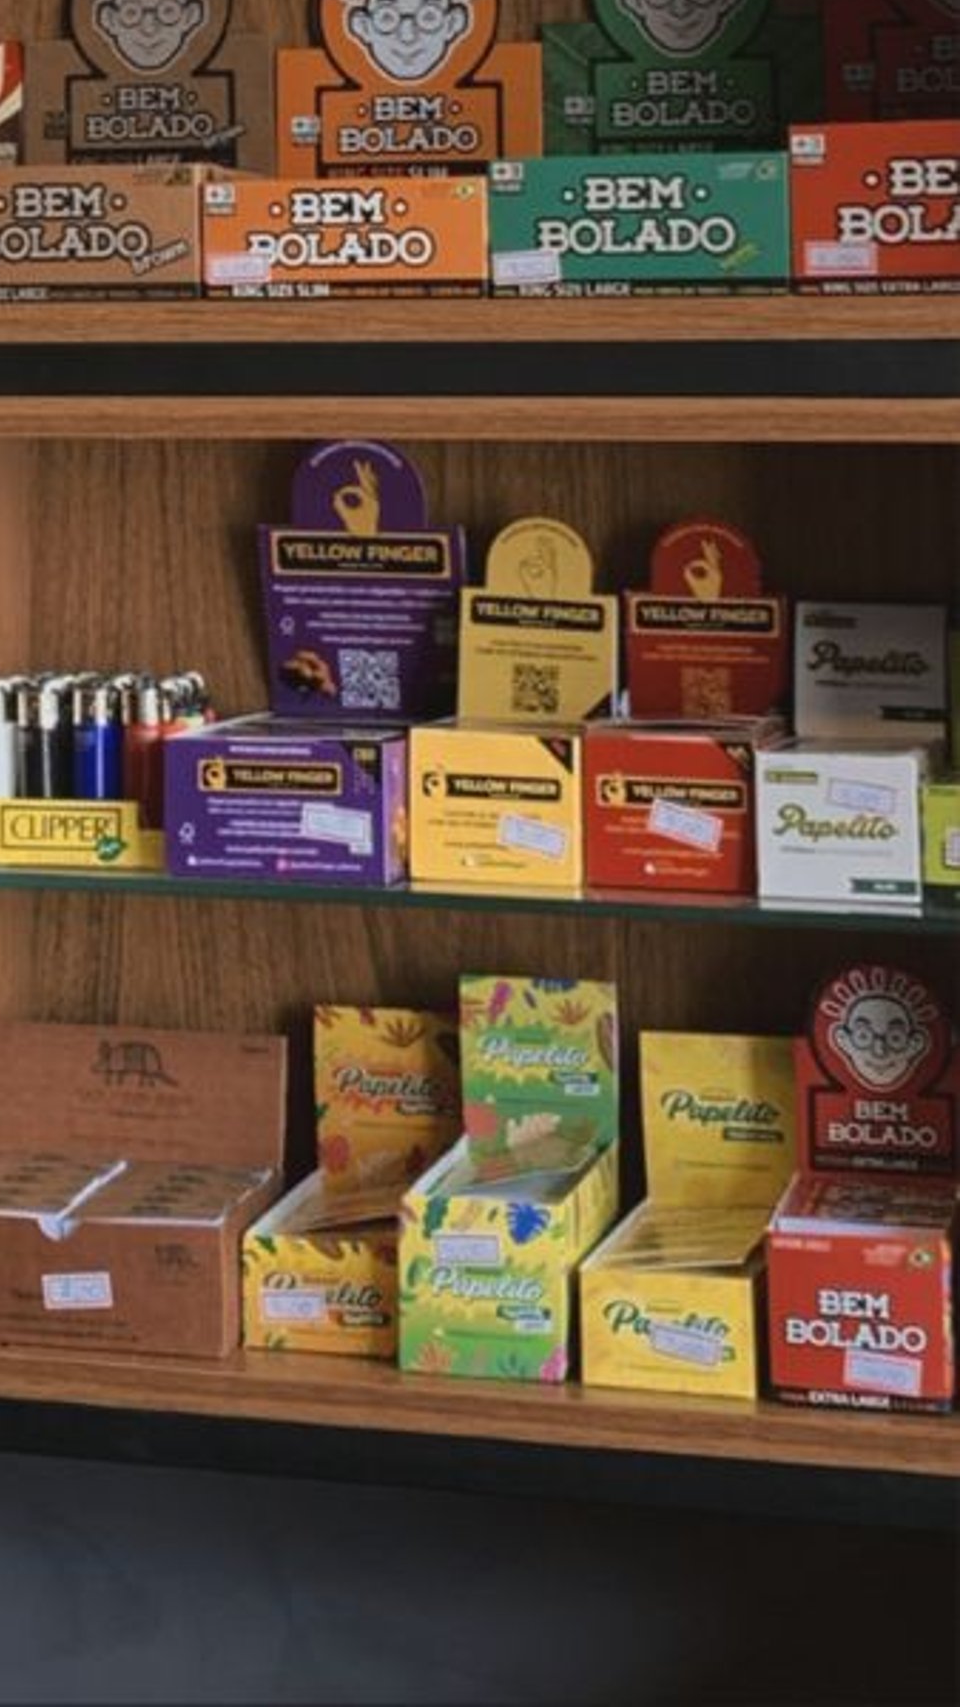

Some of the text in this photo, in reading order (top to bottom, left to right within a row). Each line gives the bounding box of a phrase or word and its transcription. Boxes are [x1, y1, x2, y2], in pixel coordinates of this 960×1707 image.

[646, 70, 718, 96] BEM
[118, 87, 182, 111] BEM
[373, 97, 444, 121] BEM
[612, 98, 755, 127] BOLADO
[86, 113, 214, 141] BOLADO
[338, 125, 478, 153] BOLADO
[890, 158, 960, 196] BE
[13, 186, 106, 219] BEM
[291, 190, 385, 225] BEM
[584, 177, 685, 211] BEM
[246, 228, 434, 267] BOLADO
[538, 216, 737, 254] BOLADO
[281, 543, 439, 563] YELLOW FINGER
[476, 601, 601, 624] YELLOW FINGER
[640, 605, 770, 626] YELLOW FINGER
[231, 769, 334, 783] YELLOW FINGER
[452, 777, 559, 796] YELLOW FINGER
[632, 783, 739, 803] YELLOW FINGER
[9, 812, 108, 839] CLIPPER
[771, 802, 899, 842] Papelito
[854, 1099, 909, 1123] BEM
[827, 1121, 938, 1148] BOLADO
[818, 1289, 892, 1320] BEM
[785, 1318, 928, 1354] BOLADO
